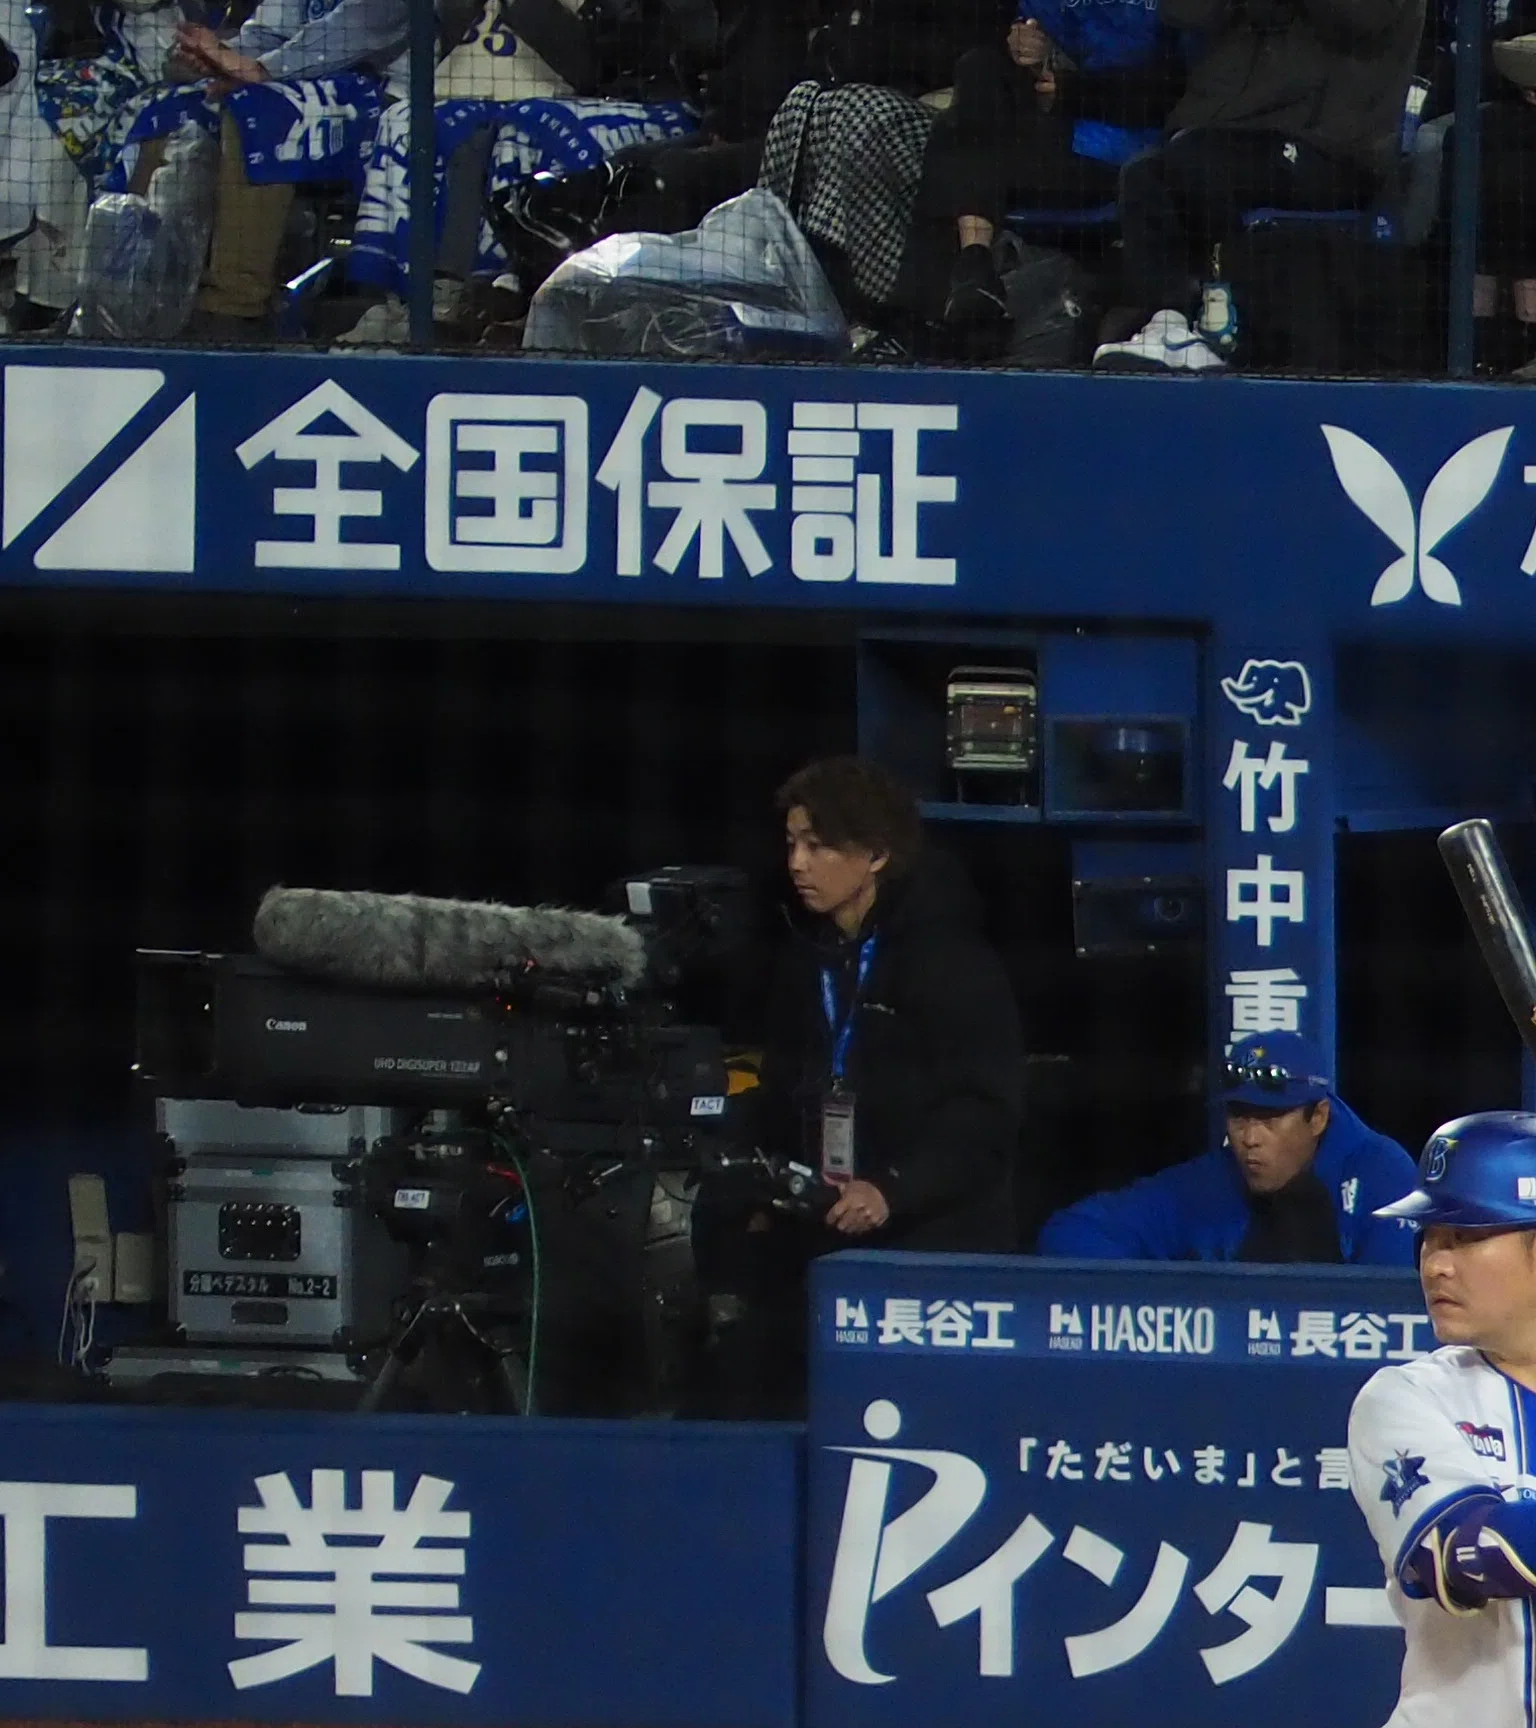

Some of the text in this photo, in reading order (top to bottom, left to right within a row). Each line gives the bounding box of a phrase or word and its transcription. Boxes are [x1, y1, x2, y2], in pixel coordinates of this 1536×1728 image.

[236, 379, 957, 585] 全国保証
[877, 1299, 1014, 1348] 長谷工
[1092, 1305, 1214, 1354] HASEKO
[1290, 1310, 1430, 1360] 長谷工
